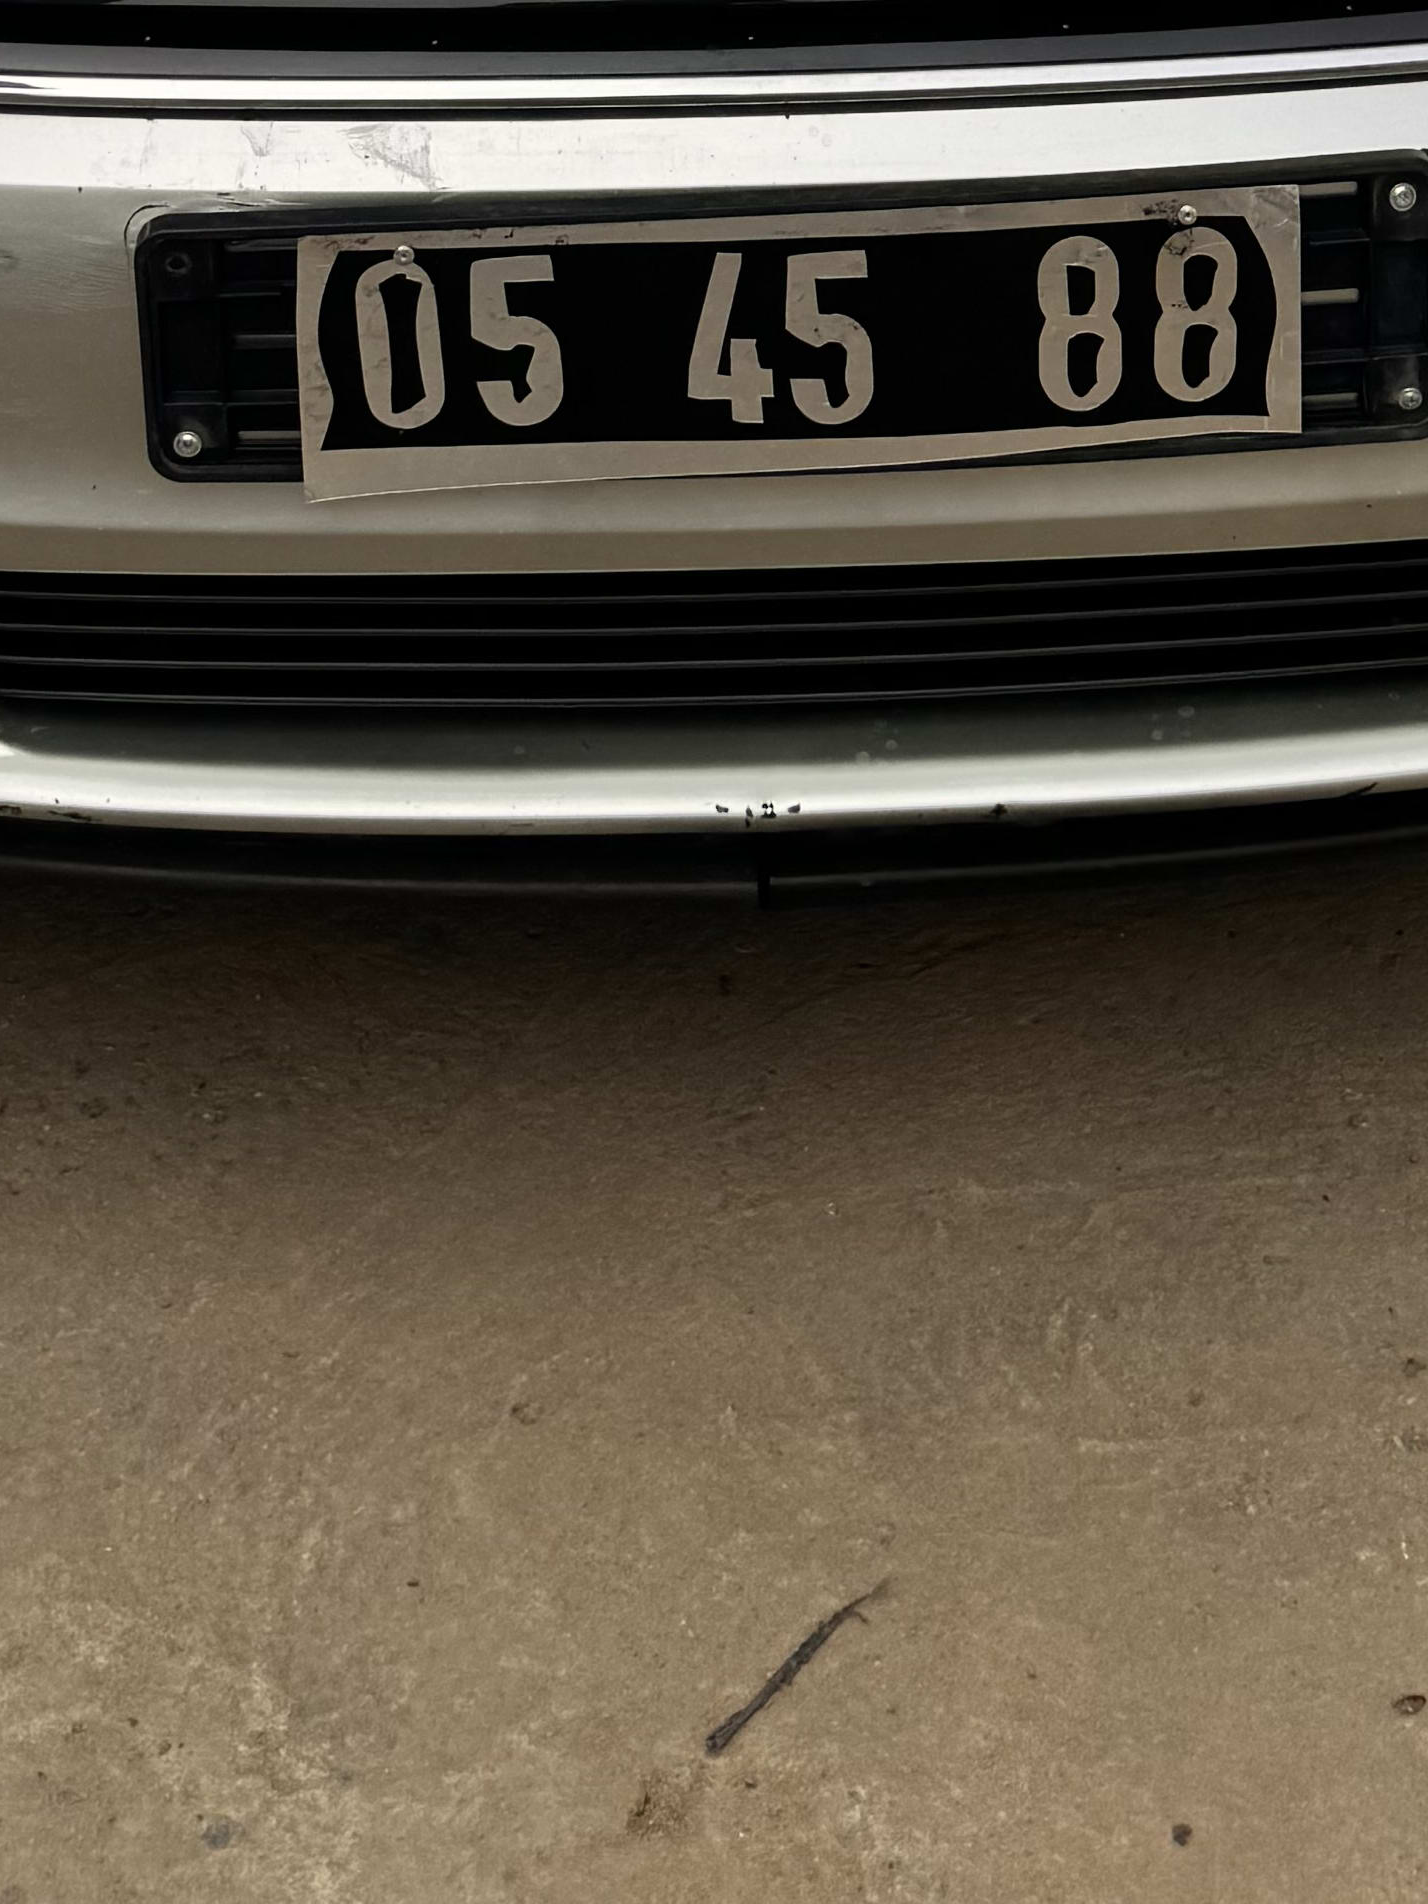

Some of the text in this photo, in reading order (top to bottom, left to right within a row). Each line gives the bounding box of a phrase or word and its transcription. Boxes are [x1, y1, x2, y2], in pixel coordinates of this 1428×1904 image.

[355, 226, 1238, 430] 05 45 88
